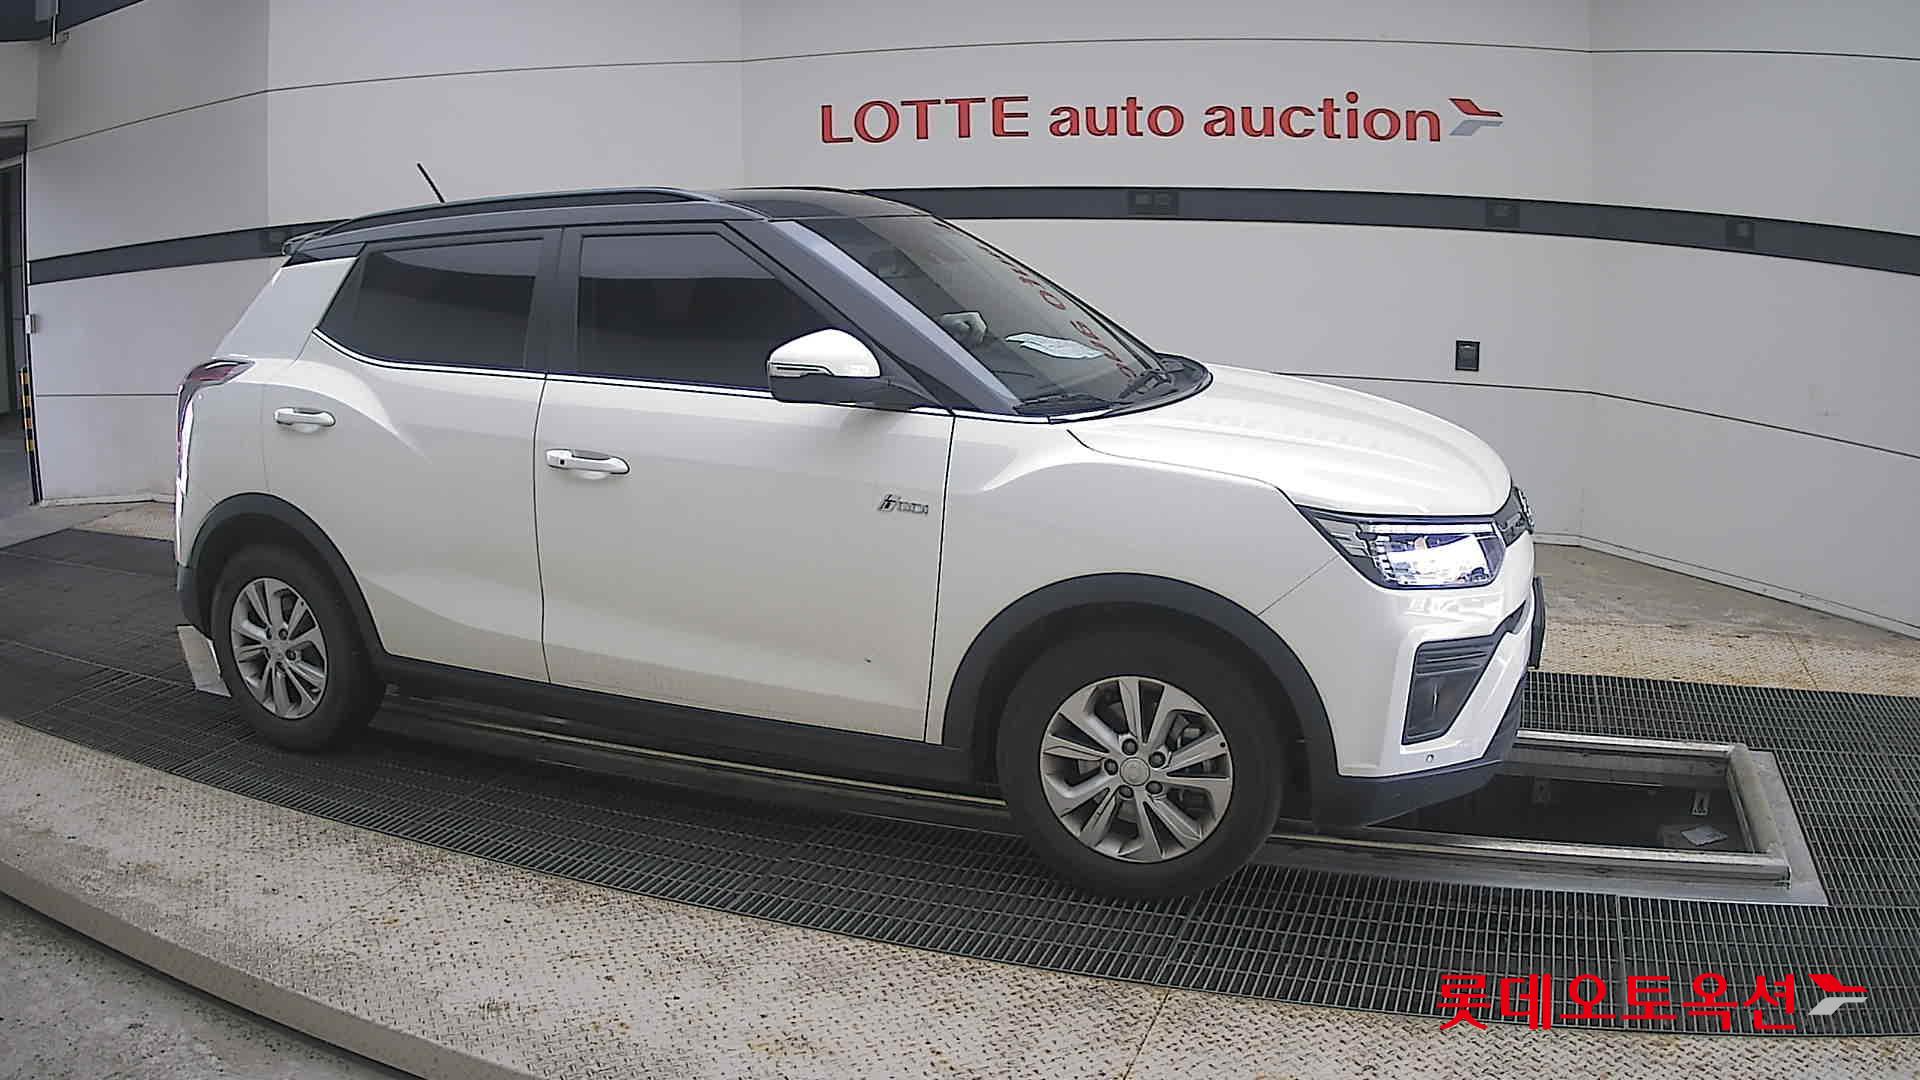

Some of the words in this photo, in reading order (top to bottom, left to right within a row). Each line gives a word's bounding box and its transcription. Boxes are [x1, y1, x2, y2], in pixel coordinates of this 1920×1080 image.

[821, 96, 1029, 144] LOTTE
[1048, 97, 1185, 138] auto
[1203, 91, 1442, 142] auction
